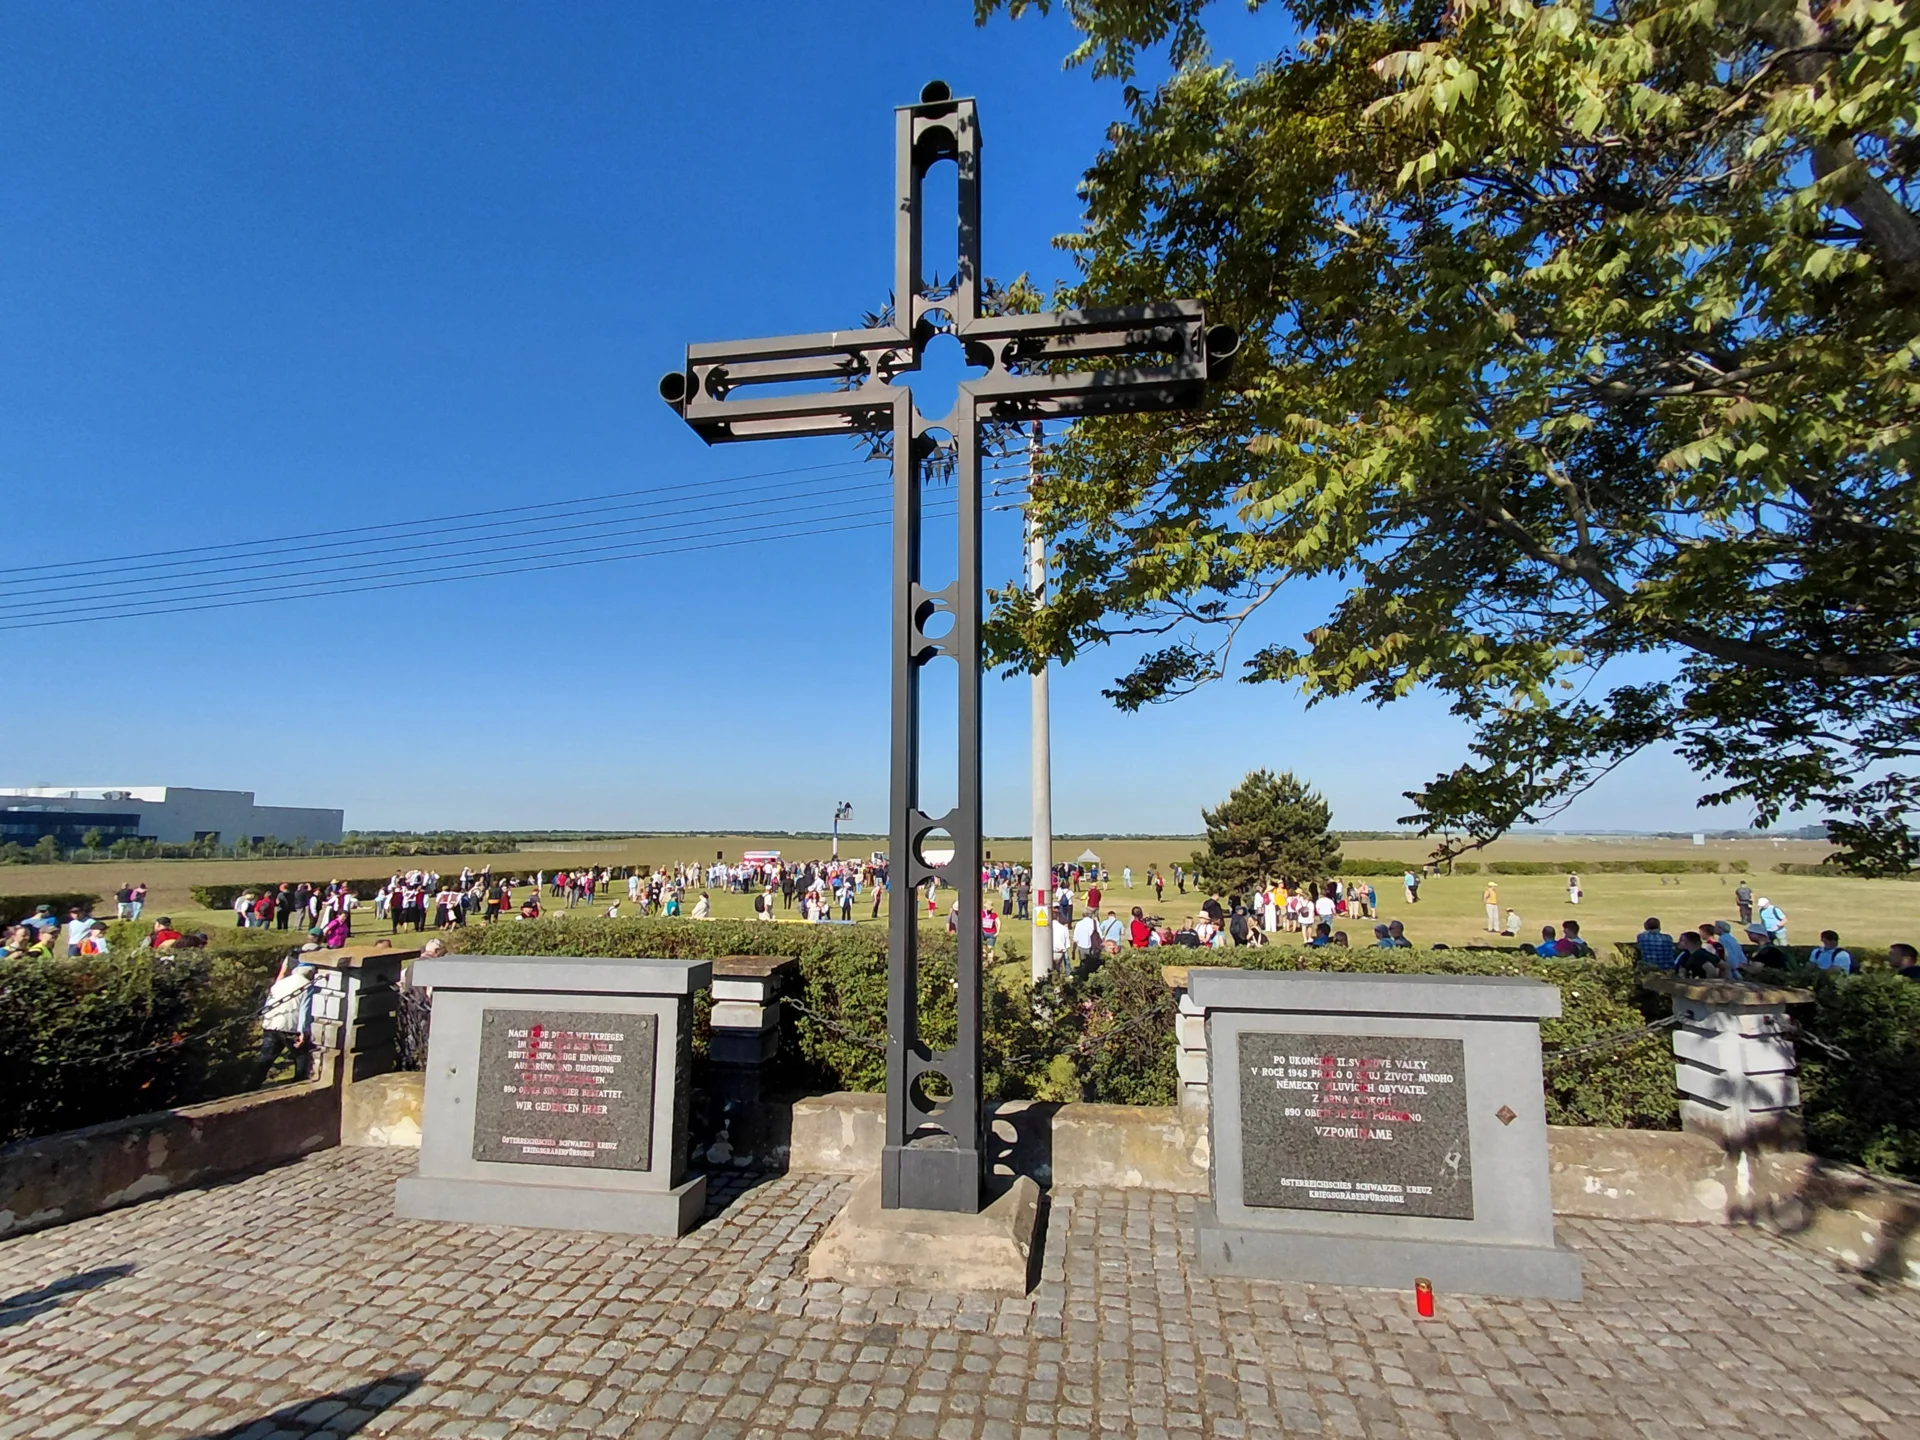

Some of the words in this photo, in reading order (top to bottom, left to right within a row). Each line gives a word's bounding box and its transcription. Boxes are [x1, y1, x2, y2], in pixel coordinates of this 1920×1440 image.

[508, 1029, 528, 1038] NACH
[575, 1032, 624, 1041] WELTKRIEGES
[517, 1040, 527, 1048] IM
[579, 1053, 622, 1063] EINWOHNER
[1273, 1056, 1285, 1065] PO
[1395, 1057, 1428, 1070] VÁLKY
[575, 1064, 614, 1074] UMGEBUNG
[1262, 1068, 1284, 1077] ROCE
[1288, 1069, 1307, 1078] 1945
[1346, 1071, 1353, 1079] O
[1384, 1070, 1414, 1082] ŽIVOT
[1419, 1073, 1454, 1083] MNOHO
[503, 1085, 516, 1093] 890
[1276, 1079, 1320, 1090] NĚMECKY
[1378, 1084, 1428, 1095] OBYVATEL
[1311, 1094, 1319, 1103] Z
[1353, 1096, 1360, 1105] A
[515, 1100, 532, 1111] WIR
[1284, 1108, 1301, 1116] 890
[1355, 1182, 1403, 1193] SCHWARZES
[1406, 1185, 1433, 1195] KREUZ
[1308, 1190, 1405, 1204] KRIEGSGRÄBERFÜRSORGE
